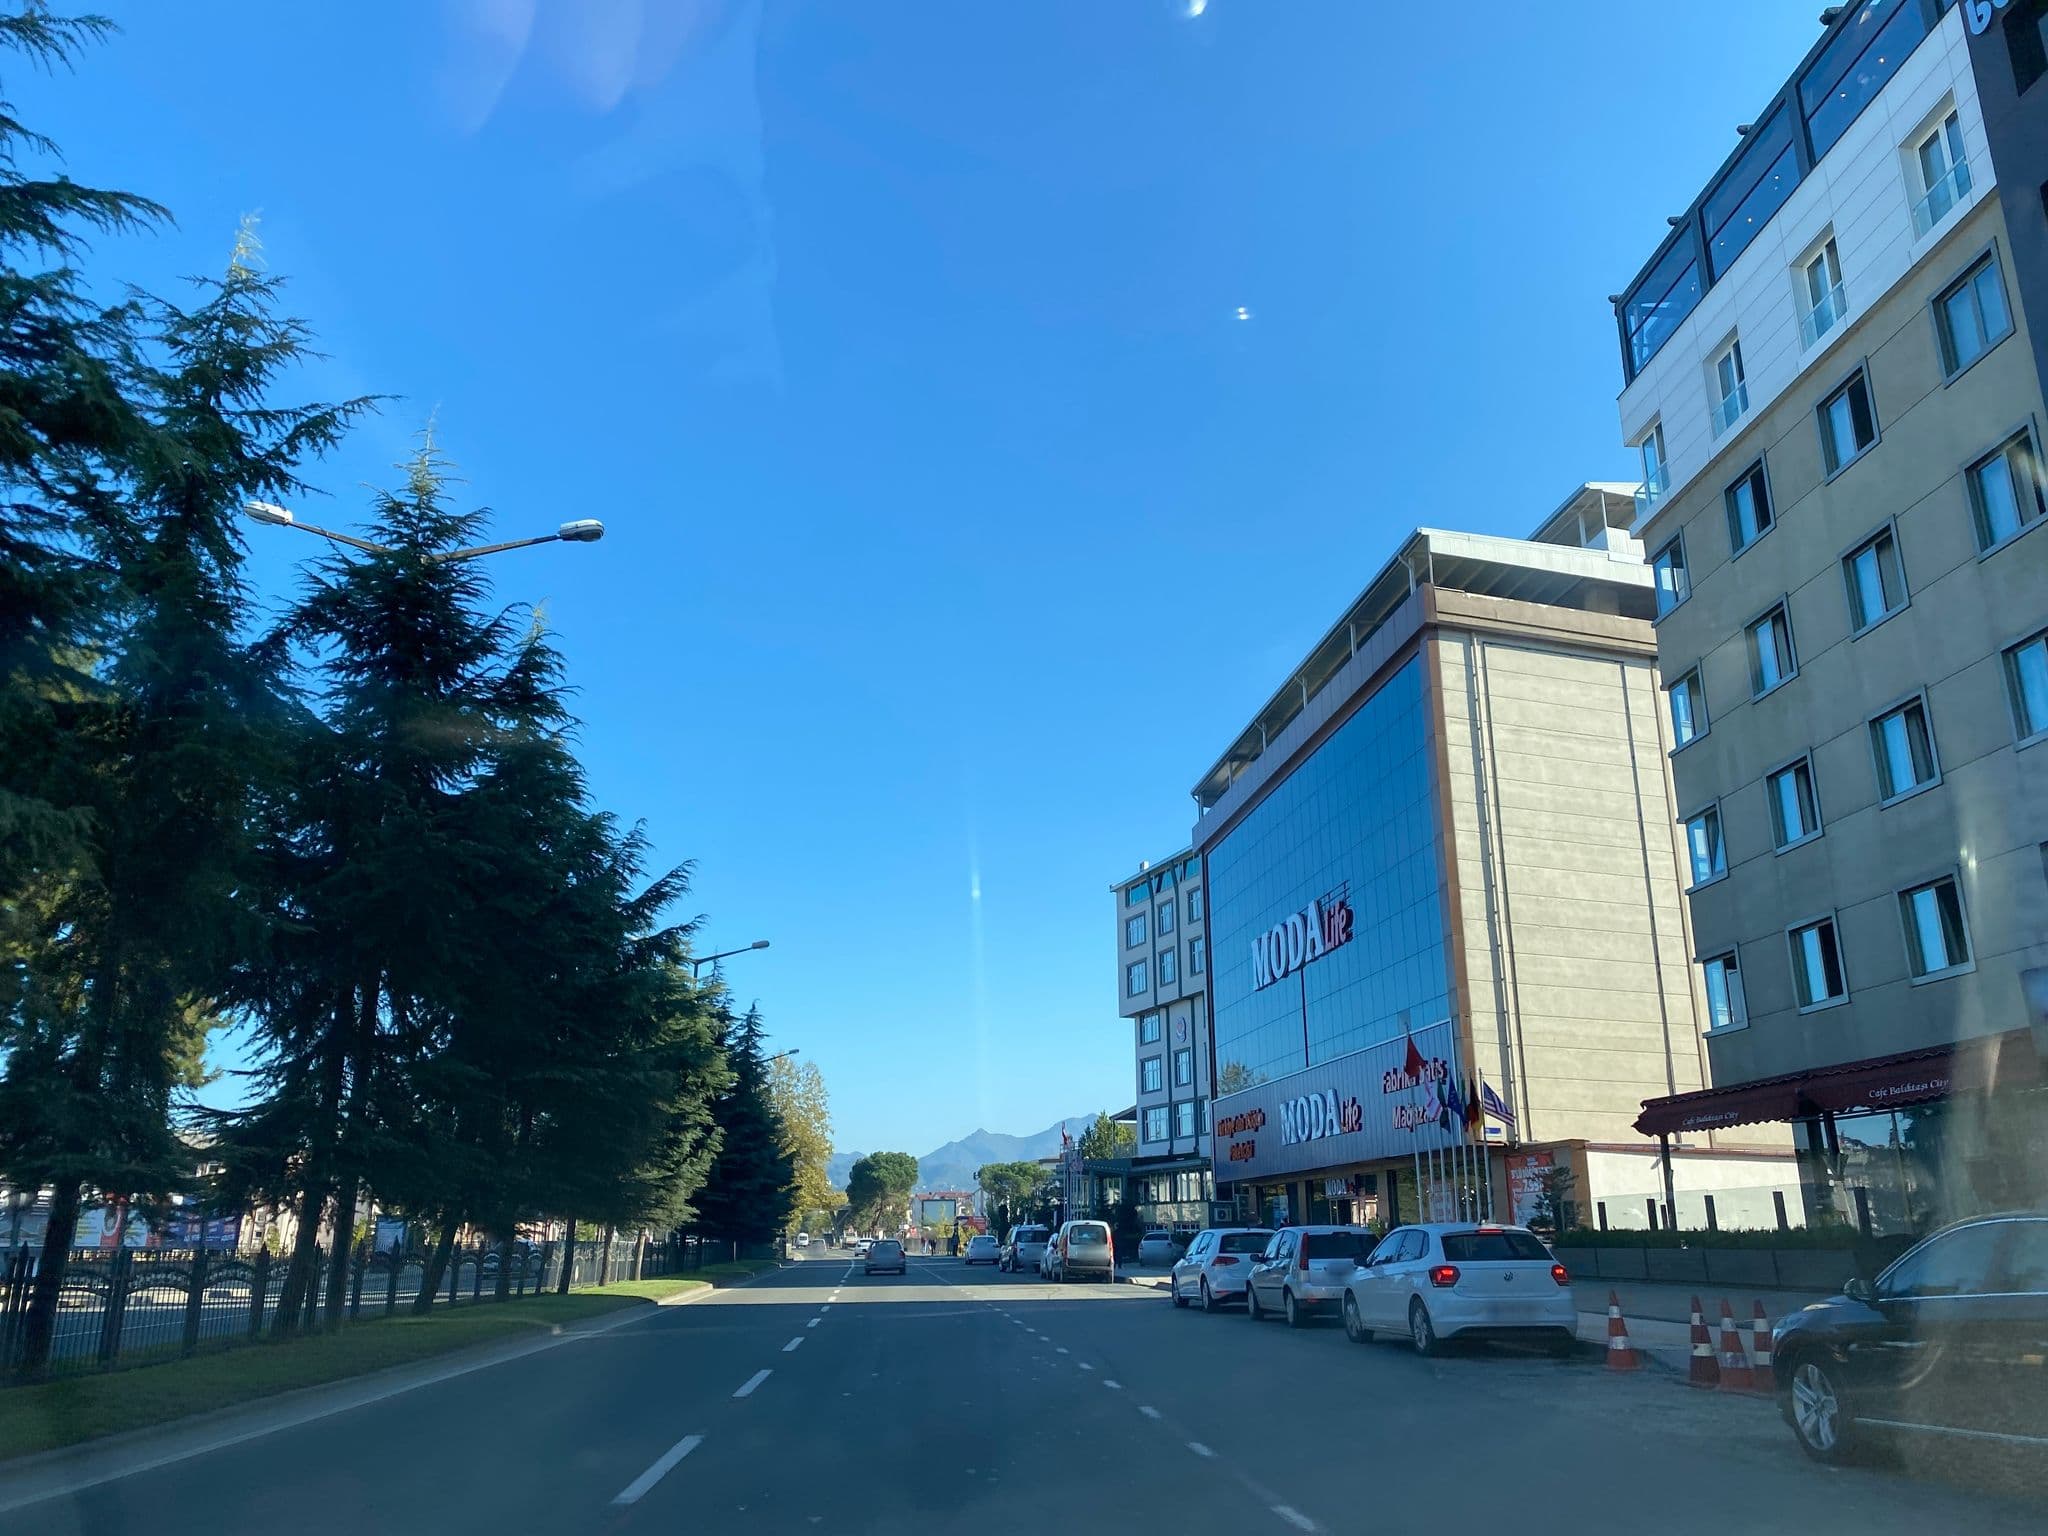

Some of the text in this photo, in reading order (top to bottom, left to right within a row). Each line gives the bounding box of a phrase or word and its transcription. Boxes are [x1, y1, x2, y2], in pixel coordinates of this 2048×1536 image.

[1251, 900, 1325, 991] MODA
[1280, 1088, 1341, 1146] MODA
[1869, 1087, 1888, 1100] Cafe
